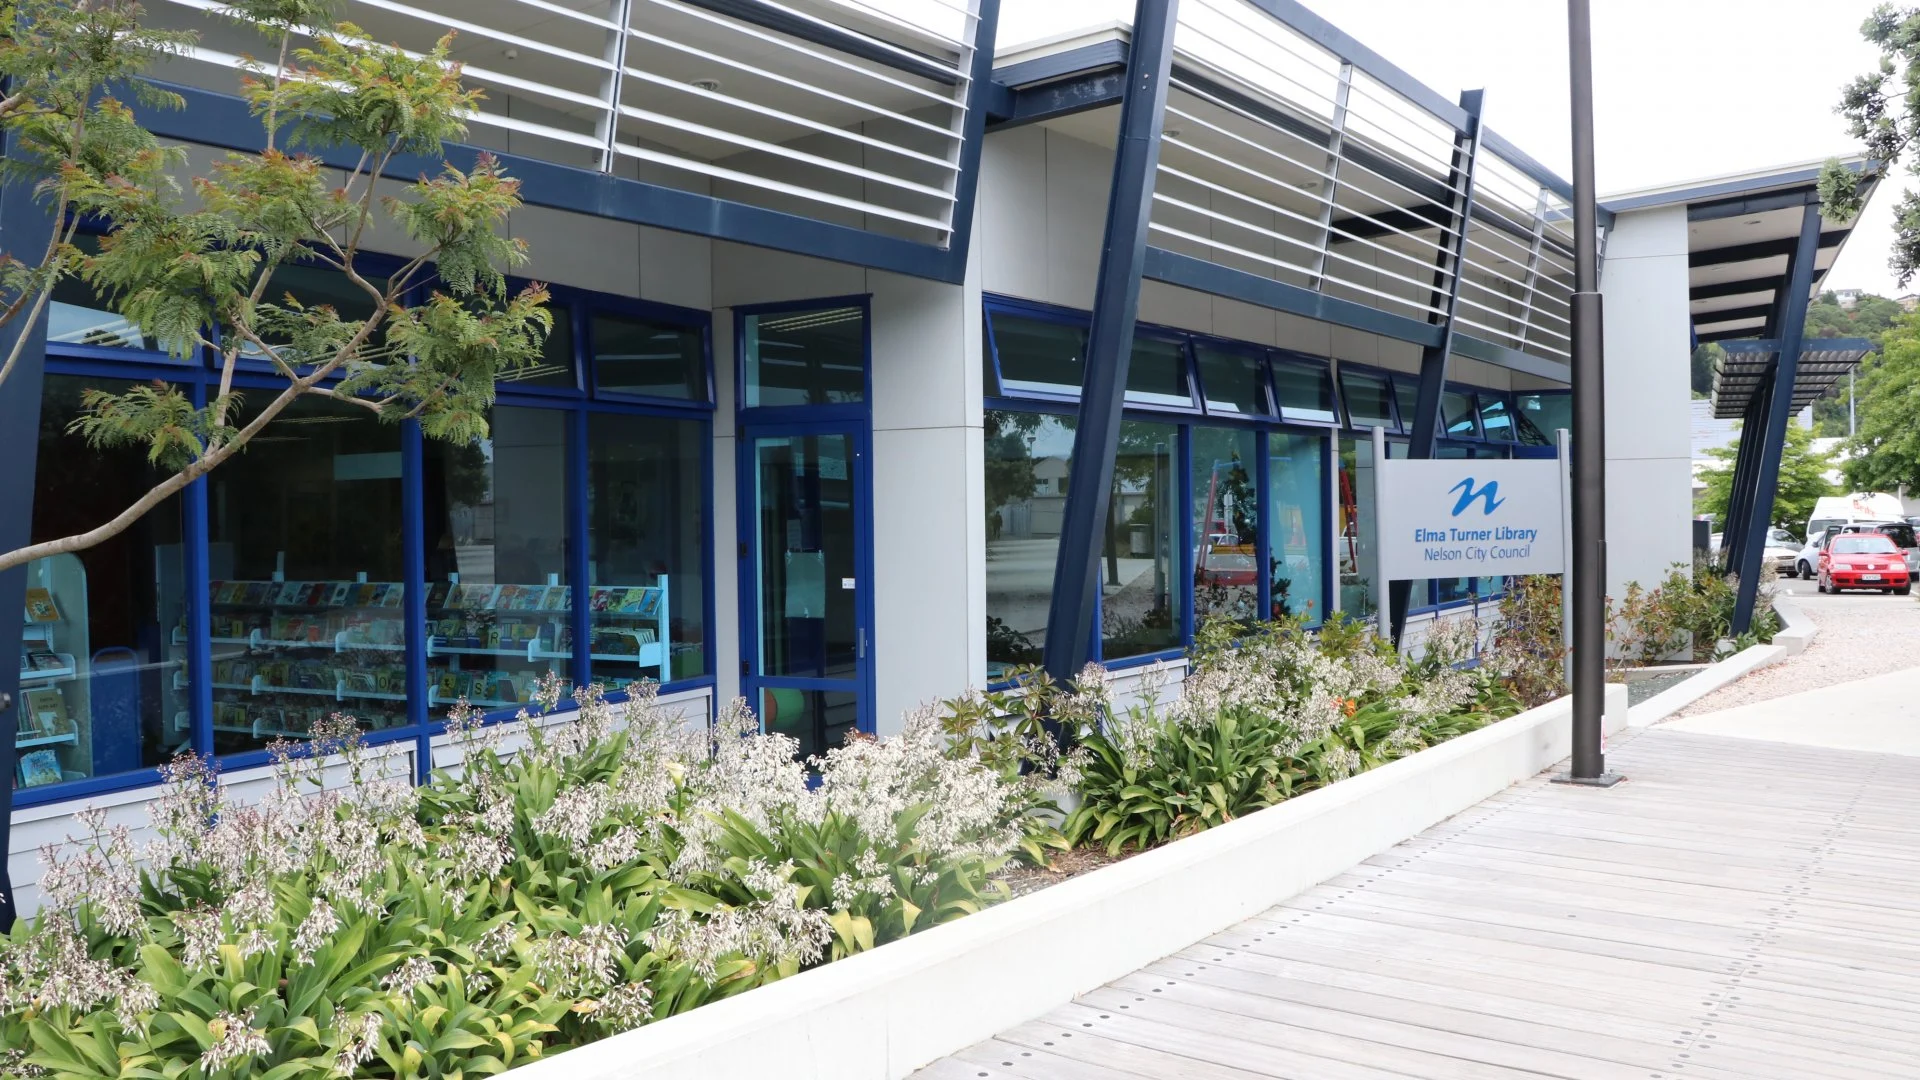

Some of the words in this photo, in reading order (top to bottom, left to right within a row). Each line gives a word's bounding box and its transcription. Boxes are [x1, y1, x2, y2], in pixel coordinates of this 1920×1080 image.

[1415, 528, 1446, 543] Elma
[1450, 528, 1492, 542] Turner
[1495, 526, 1538, 543] Library
[1424, 546, 1462, 561] Nelson
[1465, 546, 1487, 562] City
[1490, 544, 1530, 560] Council
[490, 632, 499, 644] R
[475, 683, 482, 695] S
